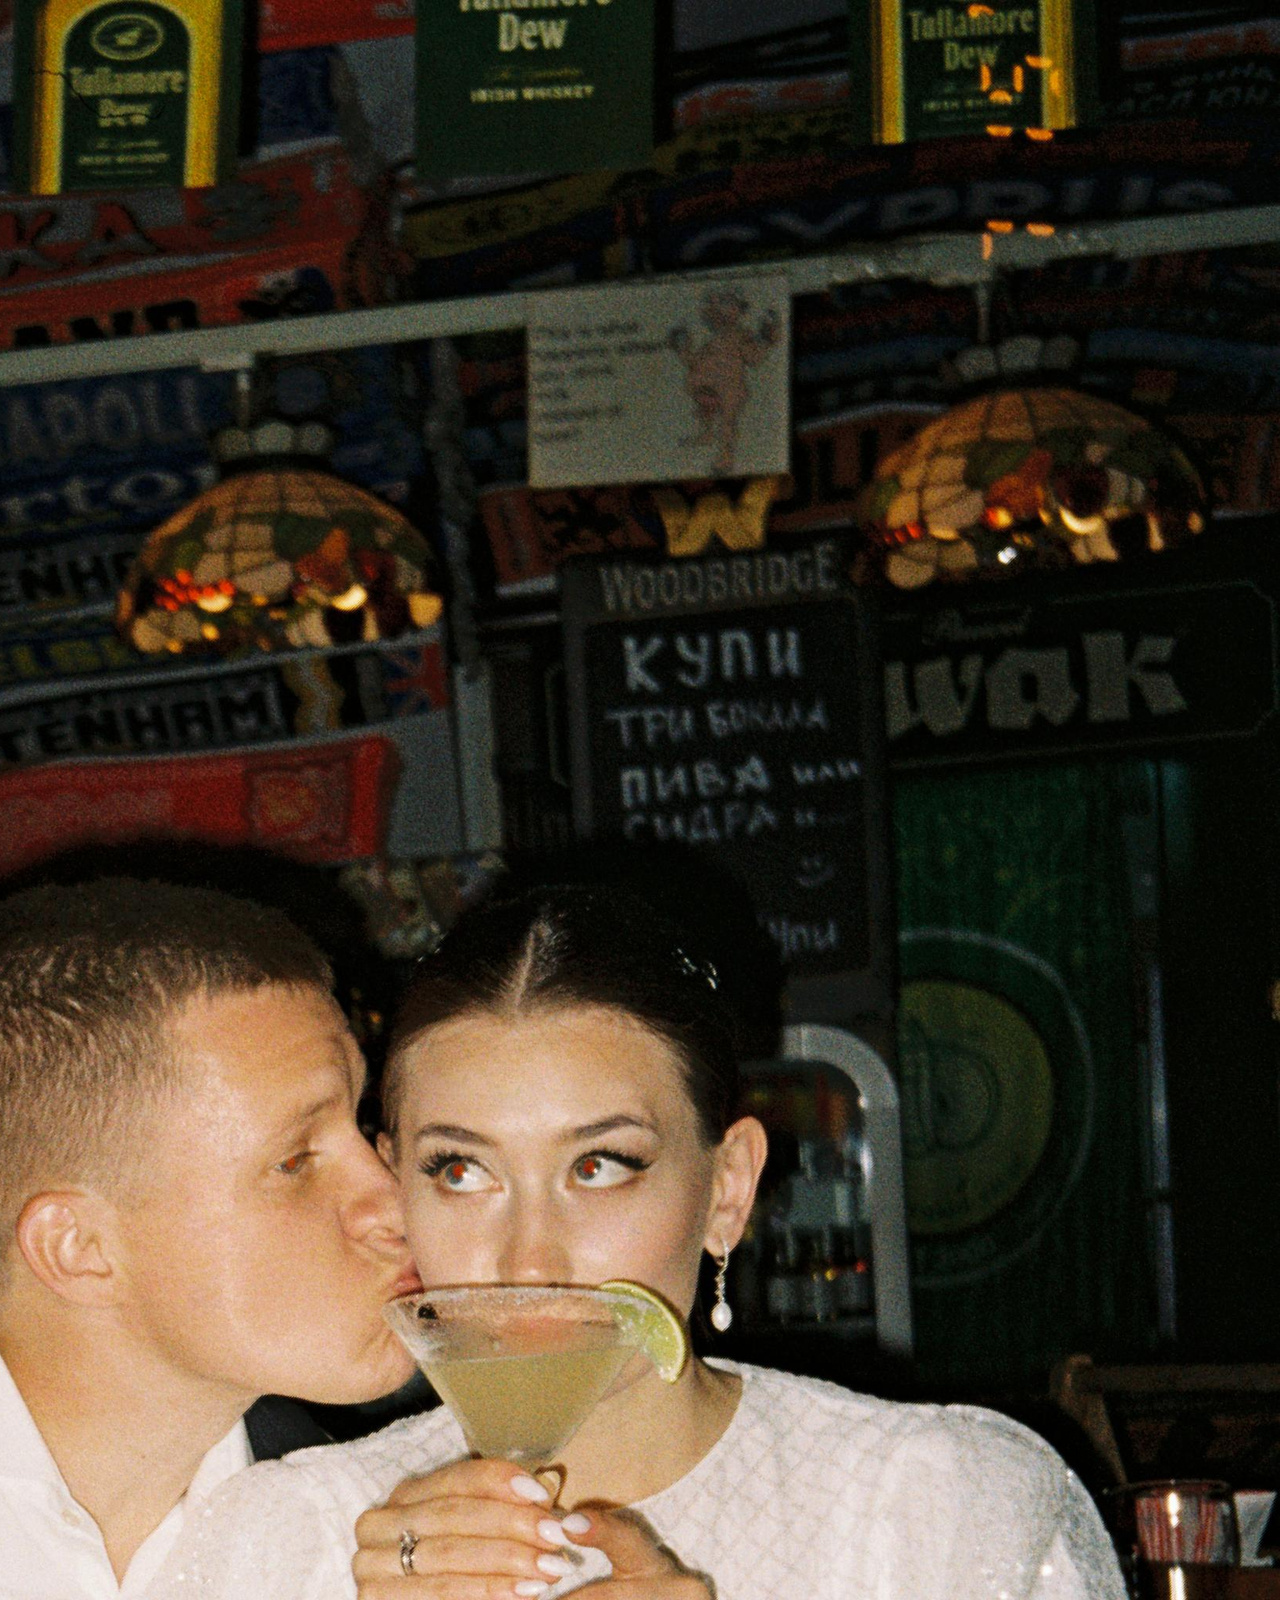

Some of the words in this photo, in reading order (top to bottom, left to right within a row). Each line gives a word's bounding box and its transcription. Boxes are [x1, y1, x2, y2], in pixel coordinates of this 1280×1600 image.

[497, 12, 569, 54] Dew
[909, 7, 1036, 42] Tullamore
[942, 41, 1001, 71] Dew
[599, 541, 839, 612] WOODBRIDGE
